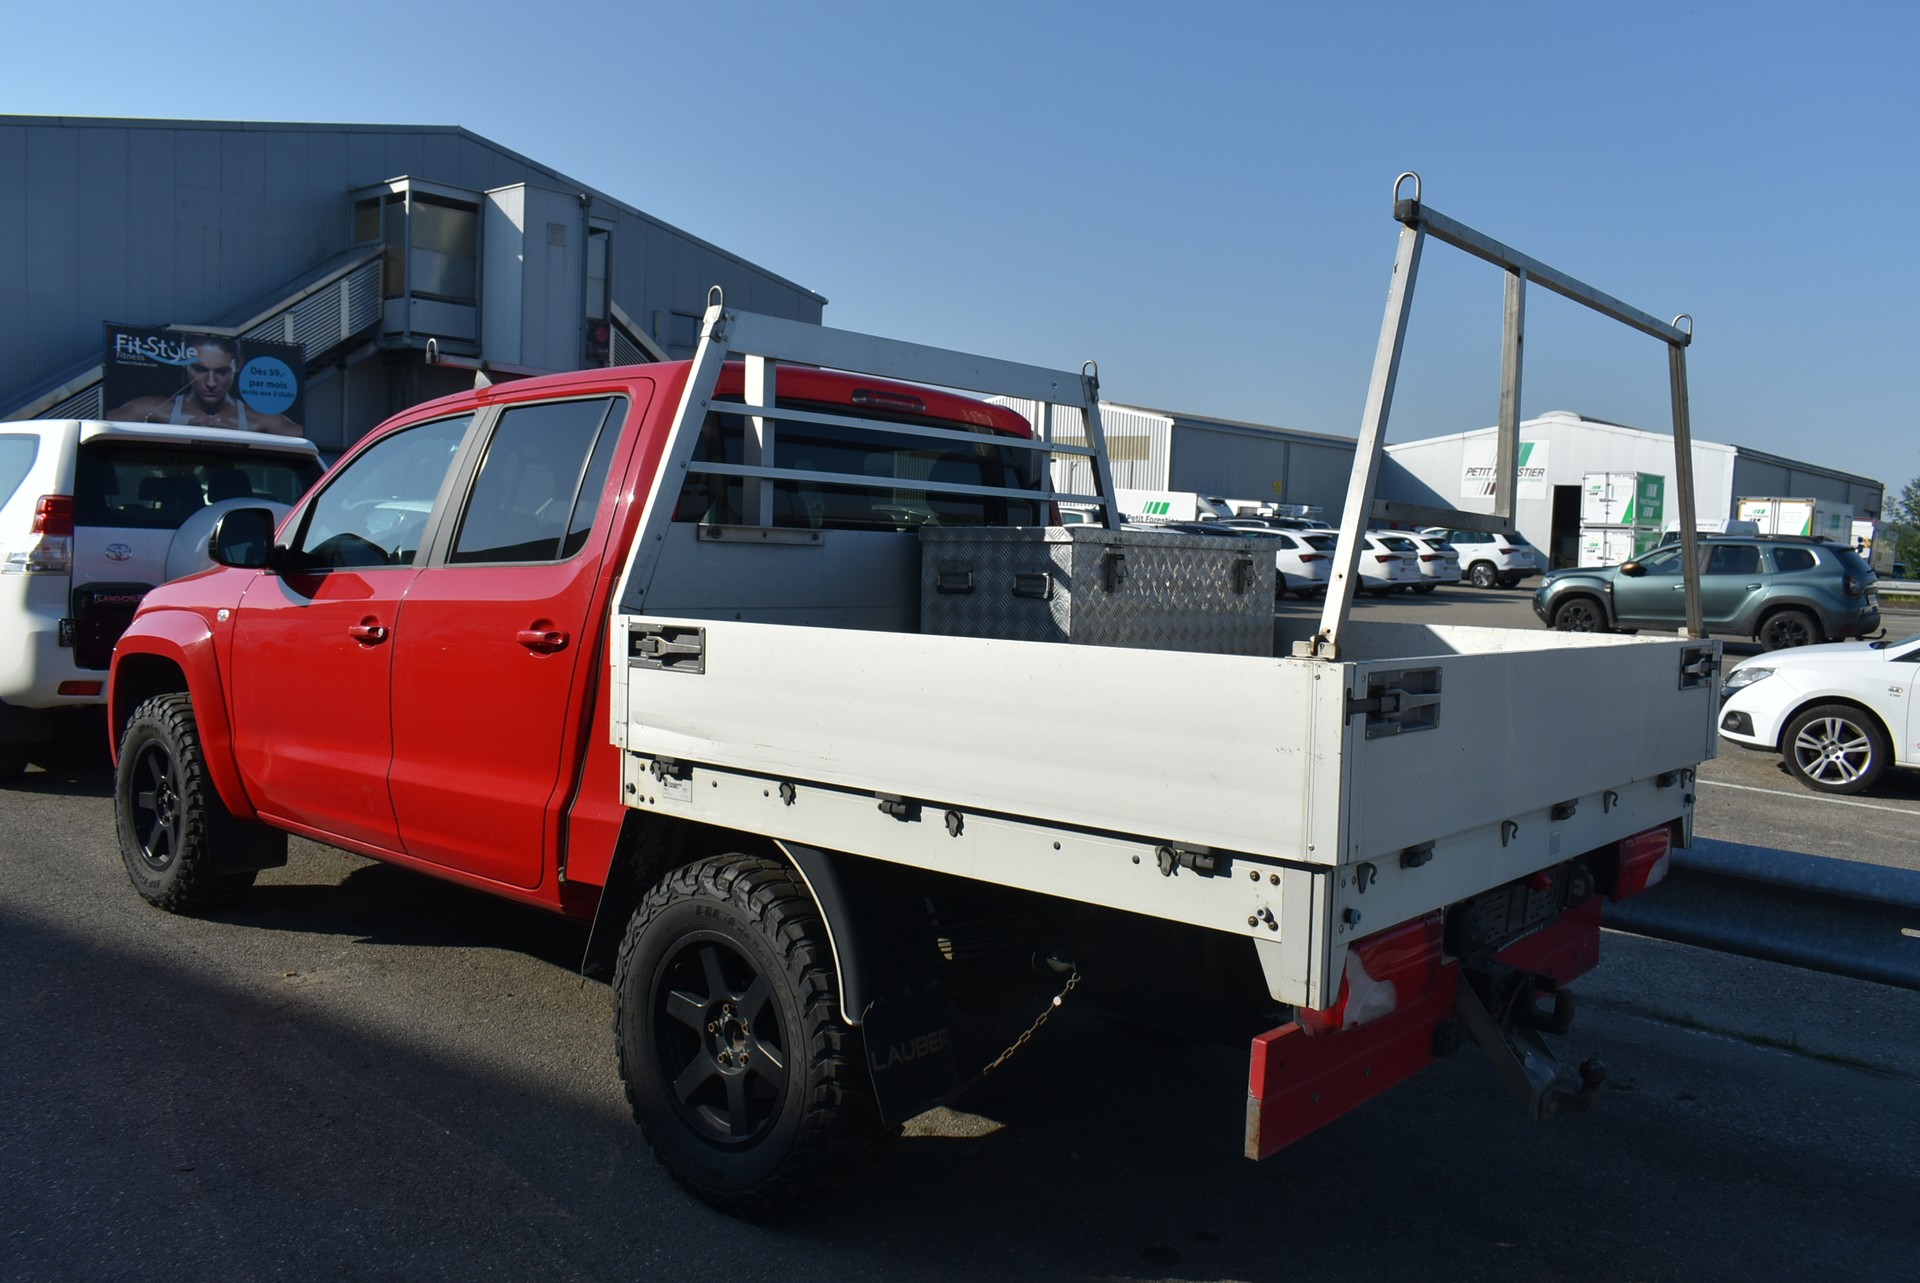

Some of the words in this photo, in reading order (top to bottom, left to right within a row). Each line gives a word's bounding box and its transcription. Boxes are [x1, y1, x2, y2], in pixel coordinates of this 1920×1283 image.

[116, 333, 198, 363] Fit-Style
[116, 352, 145, 361] Fitness
[249, 380, 264, 388] par
[265, 381, 288, 390] mois
[1465, 467, 1492, 477] PETIT
